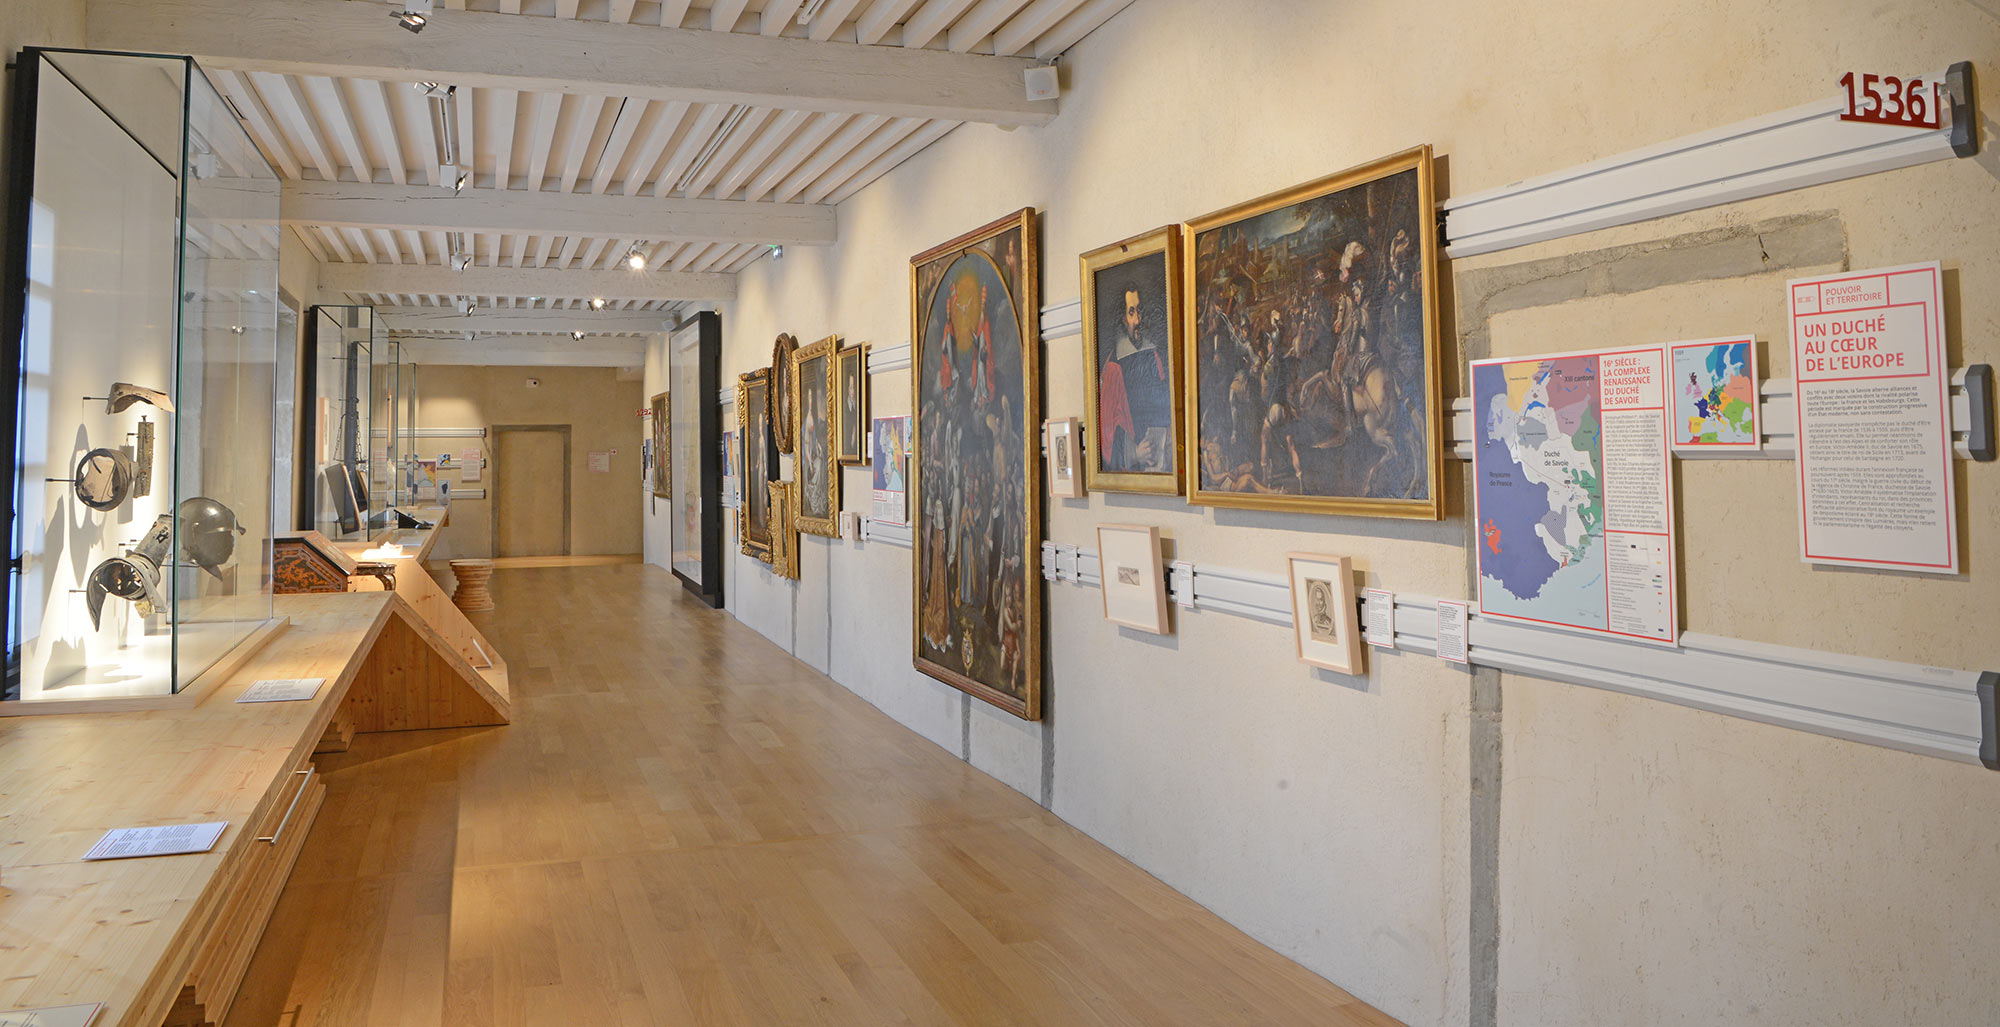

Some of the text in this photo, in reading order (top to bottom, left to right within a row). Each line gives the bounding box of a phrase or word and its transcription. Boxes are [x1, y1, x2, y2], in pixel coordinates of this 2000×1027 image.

[1840, 71, 1926, 123] 1536
[1825, 285, 1862, 297] POUVOIR
[1826, 292, 1882, 305] ET TERRITOIRE
[1804, 314, 1886, 338] UN DUCHÉ
[1804, 336, 1878, 355] AU CŒUR
[1614, 356, 1637, 367] SIÈCLE
[1806, 352, 1905, 372] DE L'EUROPE
[1603, 366, 1651, 377] LA COMPLEXE
[1603, 376, 1651, 386] RENAISSANCE
[1604, 385, 1640, 396] DU DUCHÉ
[1604, 396, 1640, 405] DE SAVOIE
[1544, 450, 1560, 458] Duché
[1552, 459, 1569, 467] Savoie
[1489, 472, 1511, 480] Royaume
[1489, 479, 1496, 487] de
